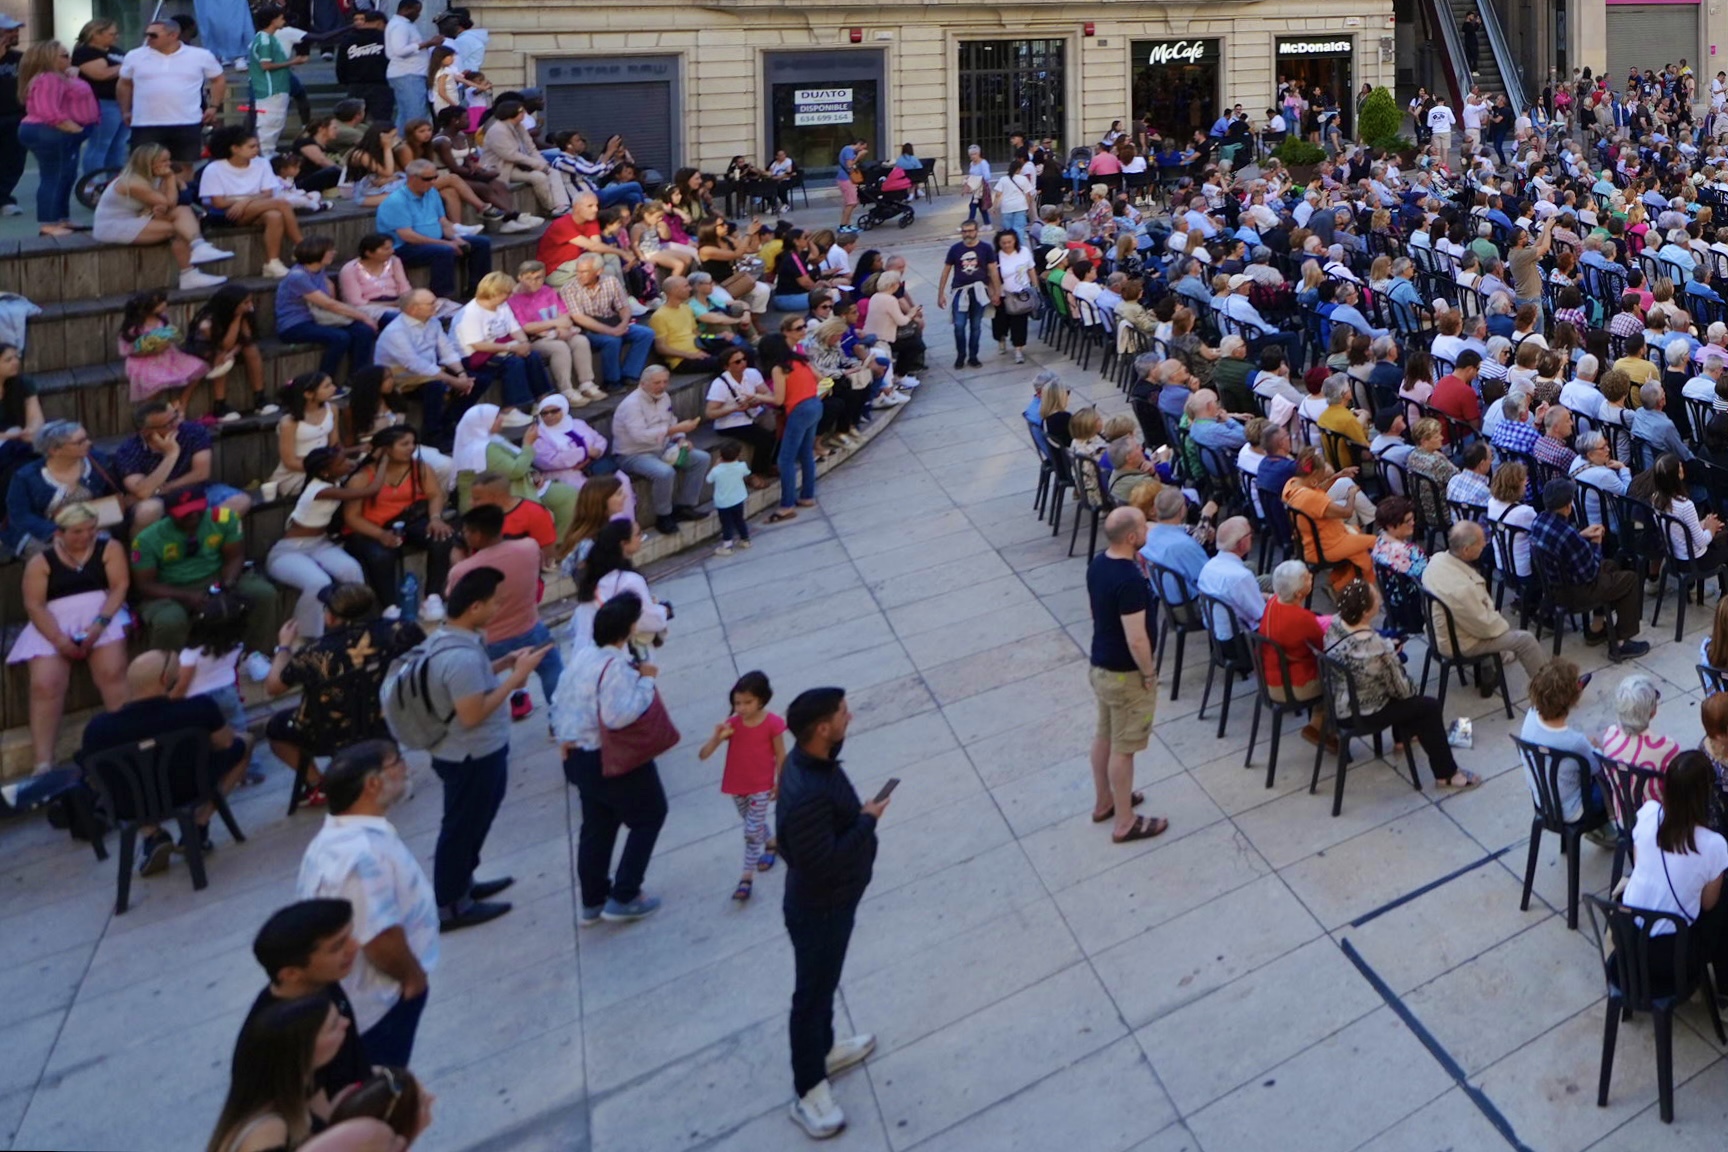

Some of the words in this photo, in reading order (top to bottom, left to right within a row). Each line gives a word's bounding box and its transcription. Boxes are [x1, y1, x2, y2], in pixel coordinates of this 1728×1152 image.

[1149, 40, 1205, 65] McCafé
[1279, 41, 1351, 54] McDonald's
[800, 103, 849, 113] DISPONIBLE
[800, 114, 815, 123] 634
